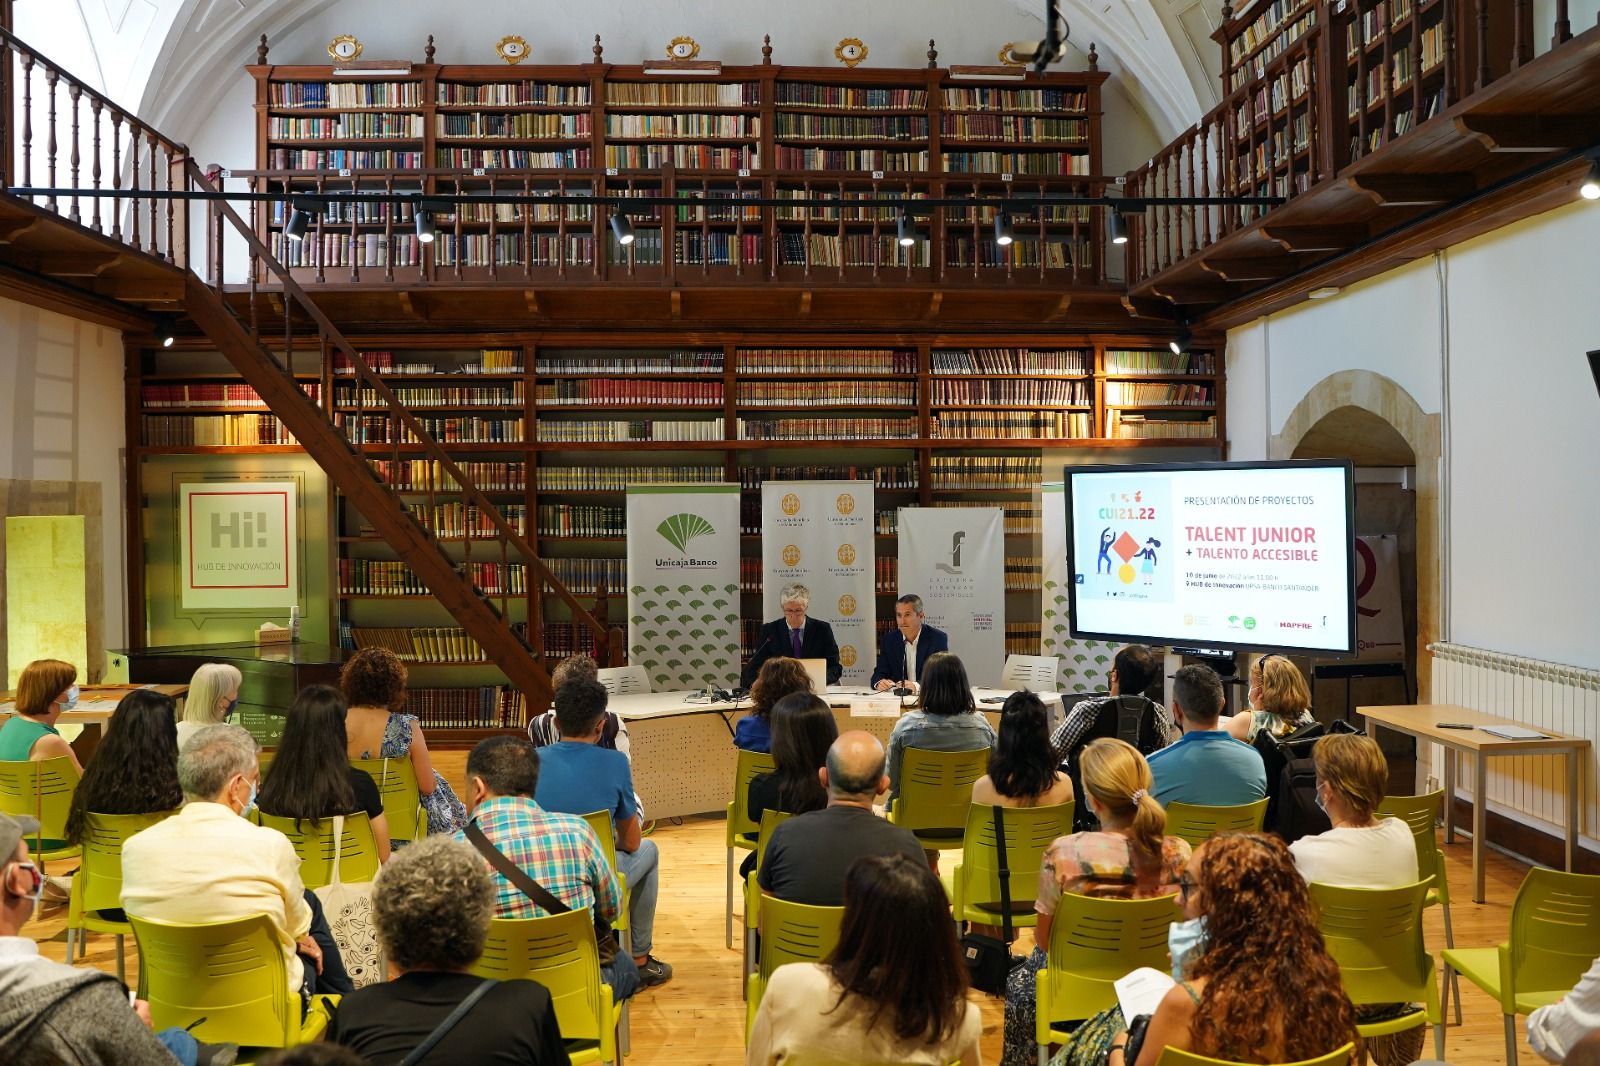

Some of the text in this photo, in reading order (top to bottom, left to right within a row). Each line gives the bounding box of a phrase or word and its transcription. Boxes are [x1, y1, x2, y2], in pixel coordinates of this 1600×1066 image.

[509, 45, 517, 53] 2
[679, 45, 685, 54] 3
[848, 47, 855, 56] 4
[1184, 495, 1315, 505] PRESENTACIÓN DE PROYECTOS
[1099, 507, 1155, 520] CUI21.22
[211, 511, 267, 548] Hi!
[1185, 526, 1316, 545] TALENT JUNIOR
[1196, 548, 1248, 560] TALENTO
[1252, 548, 1319, 562] ACCESIBLE
[197, 561, 281, 571] HUB DE INNOVACIÓN
